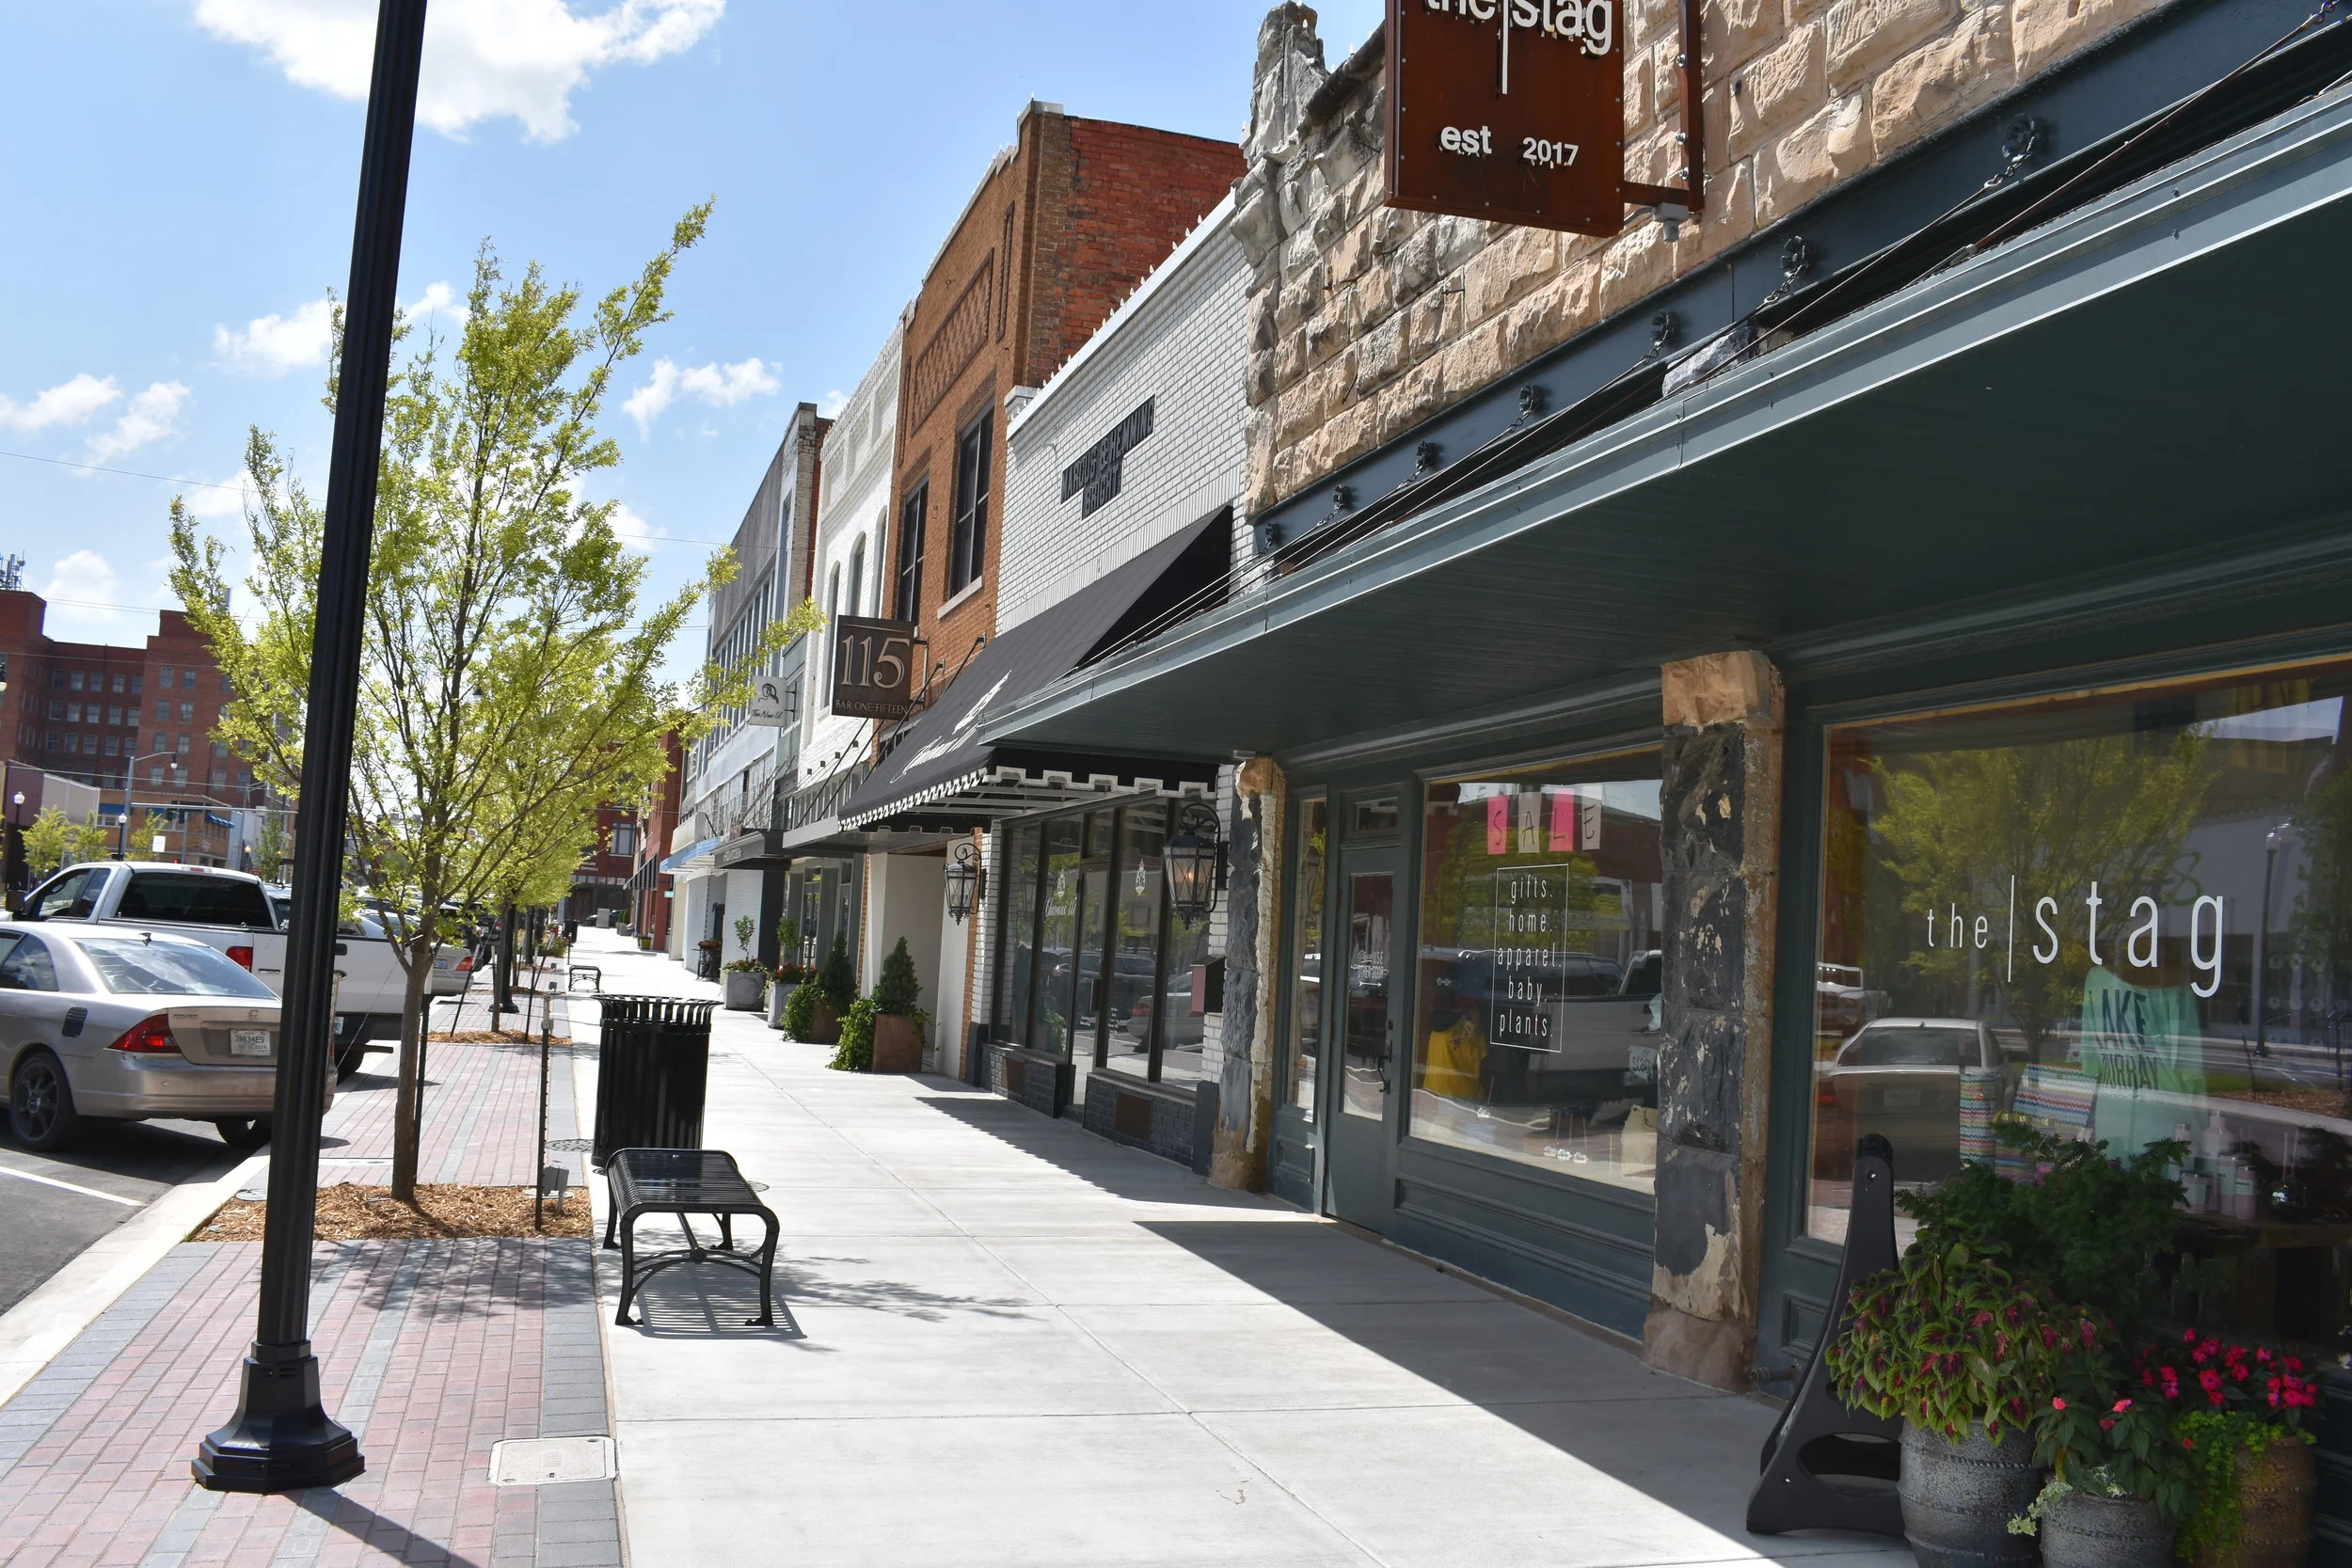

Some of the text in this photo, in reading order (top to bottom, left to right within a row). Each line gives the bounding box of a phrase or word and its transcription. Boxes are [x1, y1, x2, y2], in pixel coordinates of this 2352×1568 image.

[1439, 125, 1580, 166] est 2017
[840, 634, 911, 689] 115
[835, 699, 851, 709] BAR
[1491, 803, 1597, 847] SALE
[1510, 875, 1552, 904] gifts.
[1508, 911, 1552, 932] home.
[1926, 880, 2224, 998] the stag
[1373, 951, 1384, 965] USE
[1497, 942, 1562, 972] apparel.
[1507, 975, 1548, 1007] baby.
[1499, 1009, 1553, 1037] plants.
